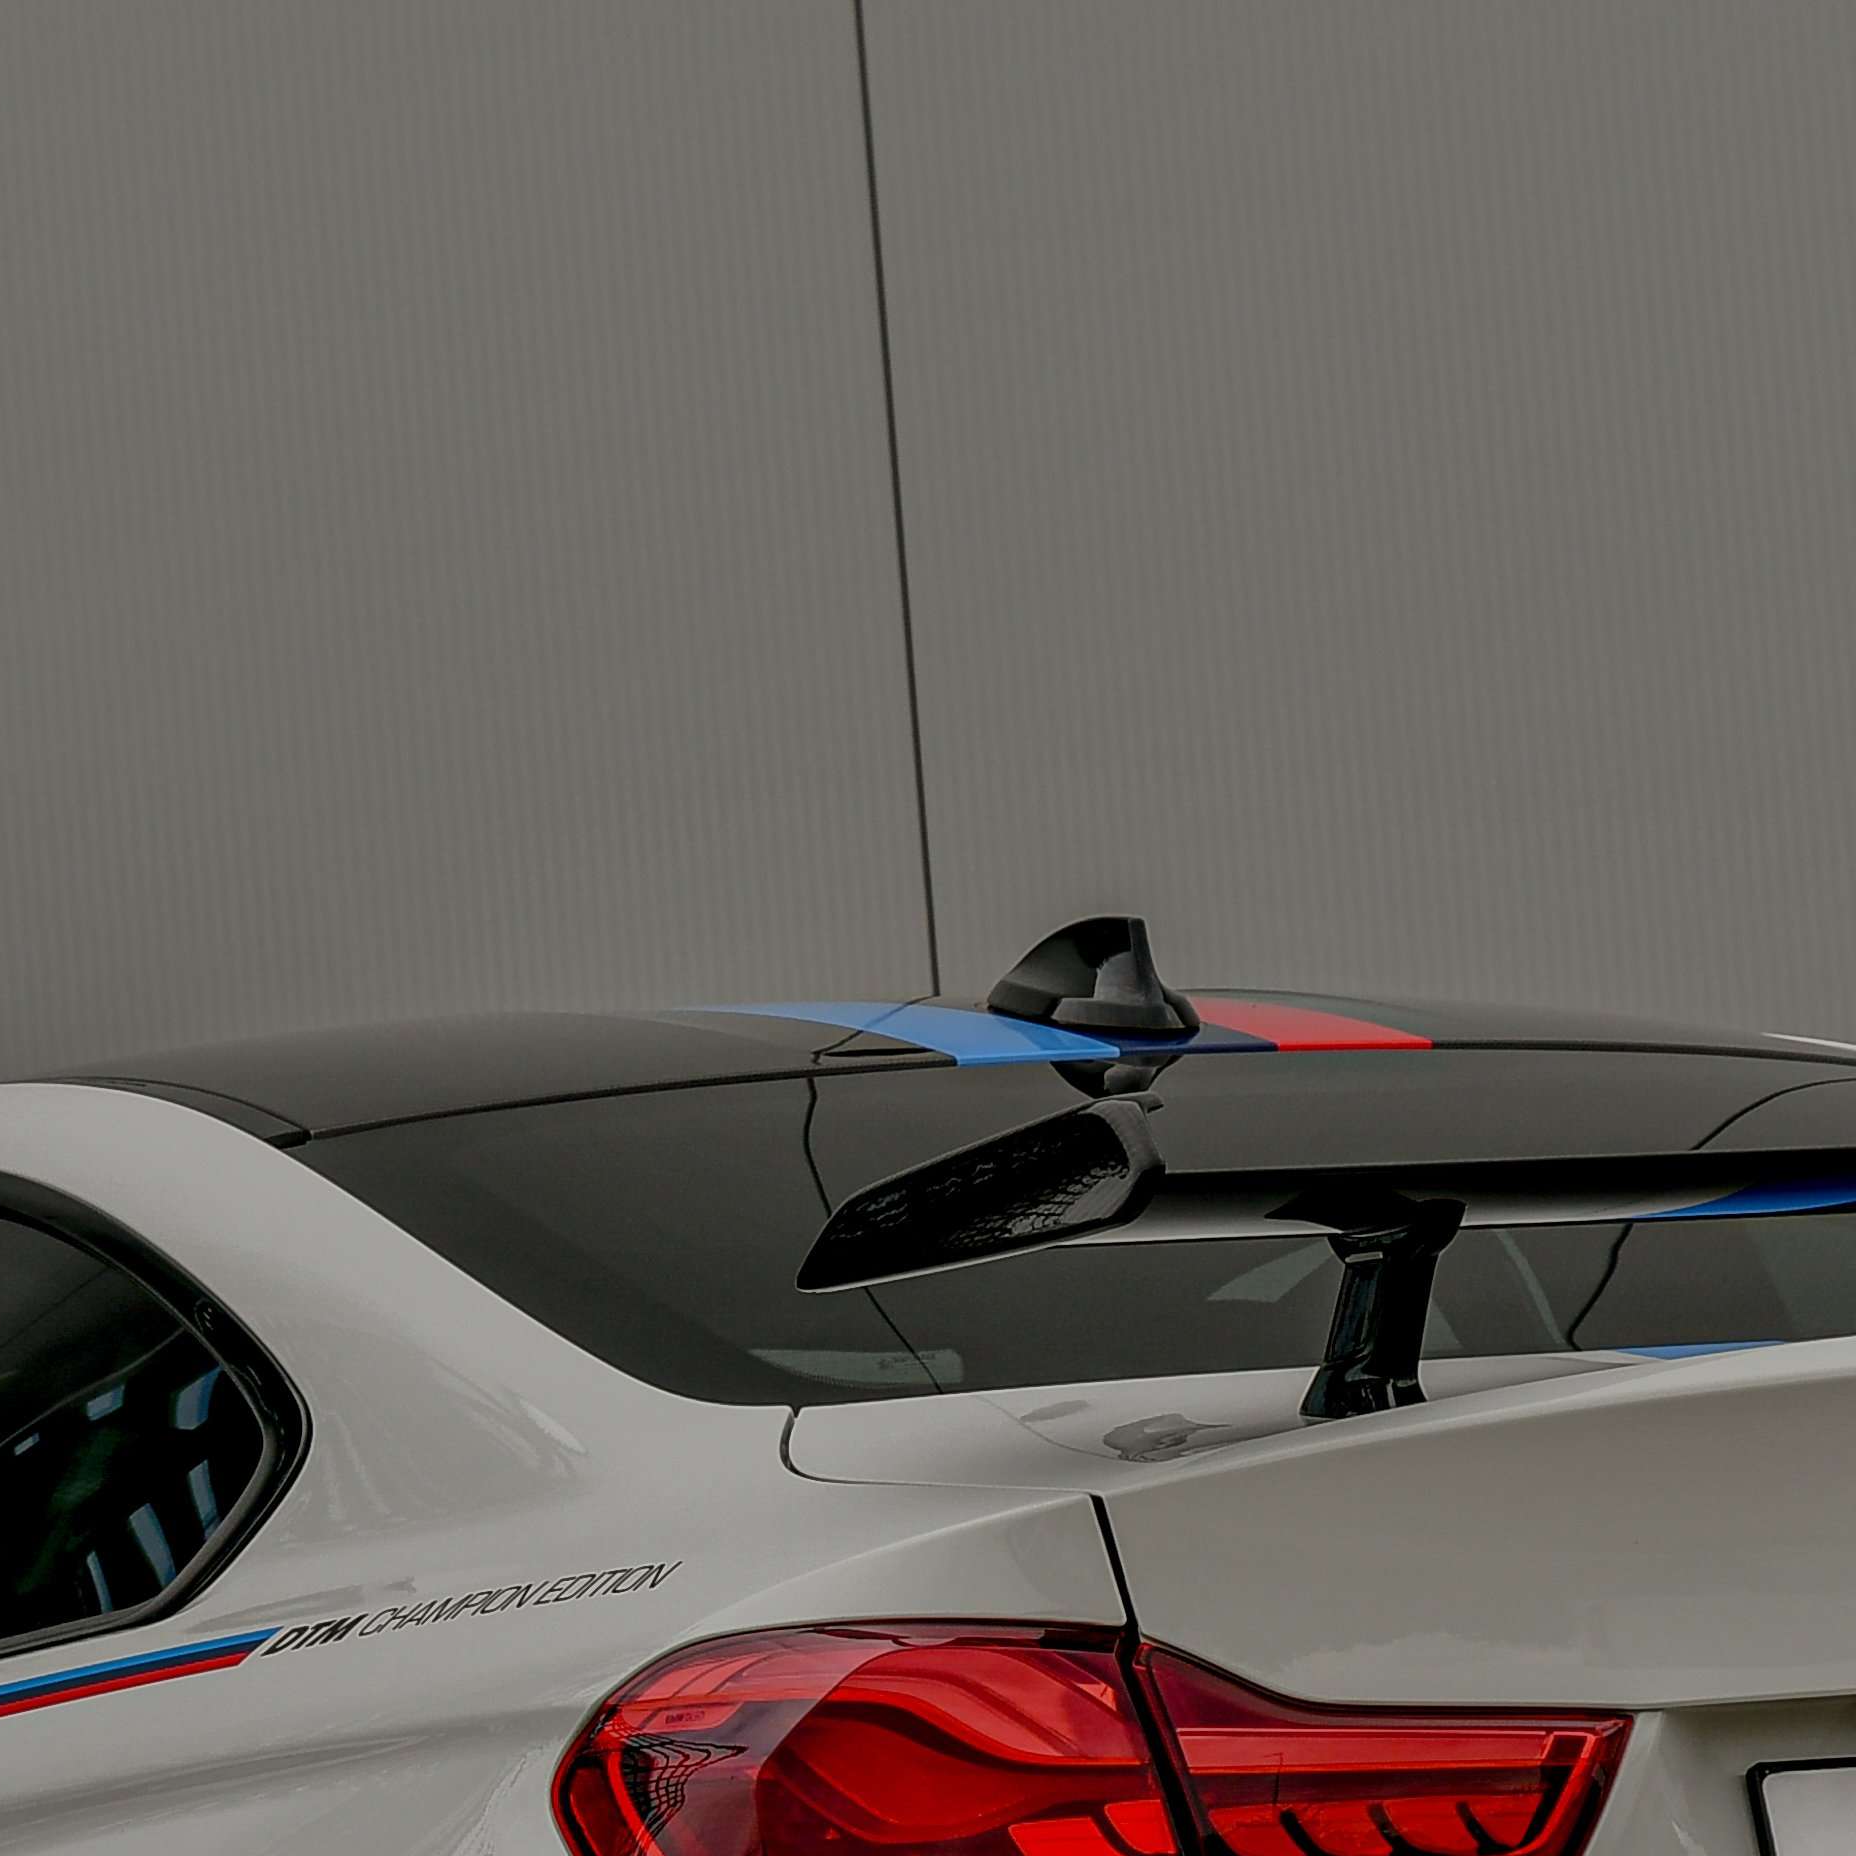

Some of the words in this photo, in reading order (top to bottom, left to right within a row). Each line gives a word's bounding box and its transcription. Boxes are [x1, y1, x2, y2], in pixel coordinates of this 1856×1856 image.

[261, 1614, 369, 1656] DTM
[358, 1580, 537, 1636] CHAMPION
[532, 1561, 683, 1605] EDITION
